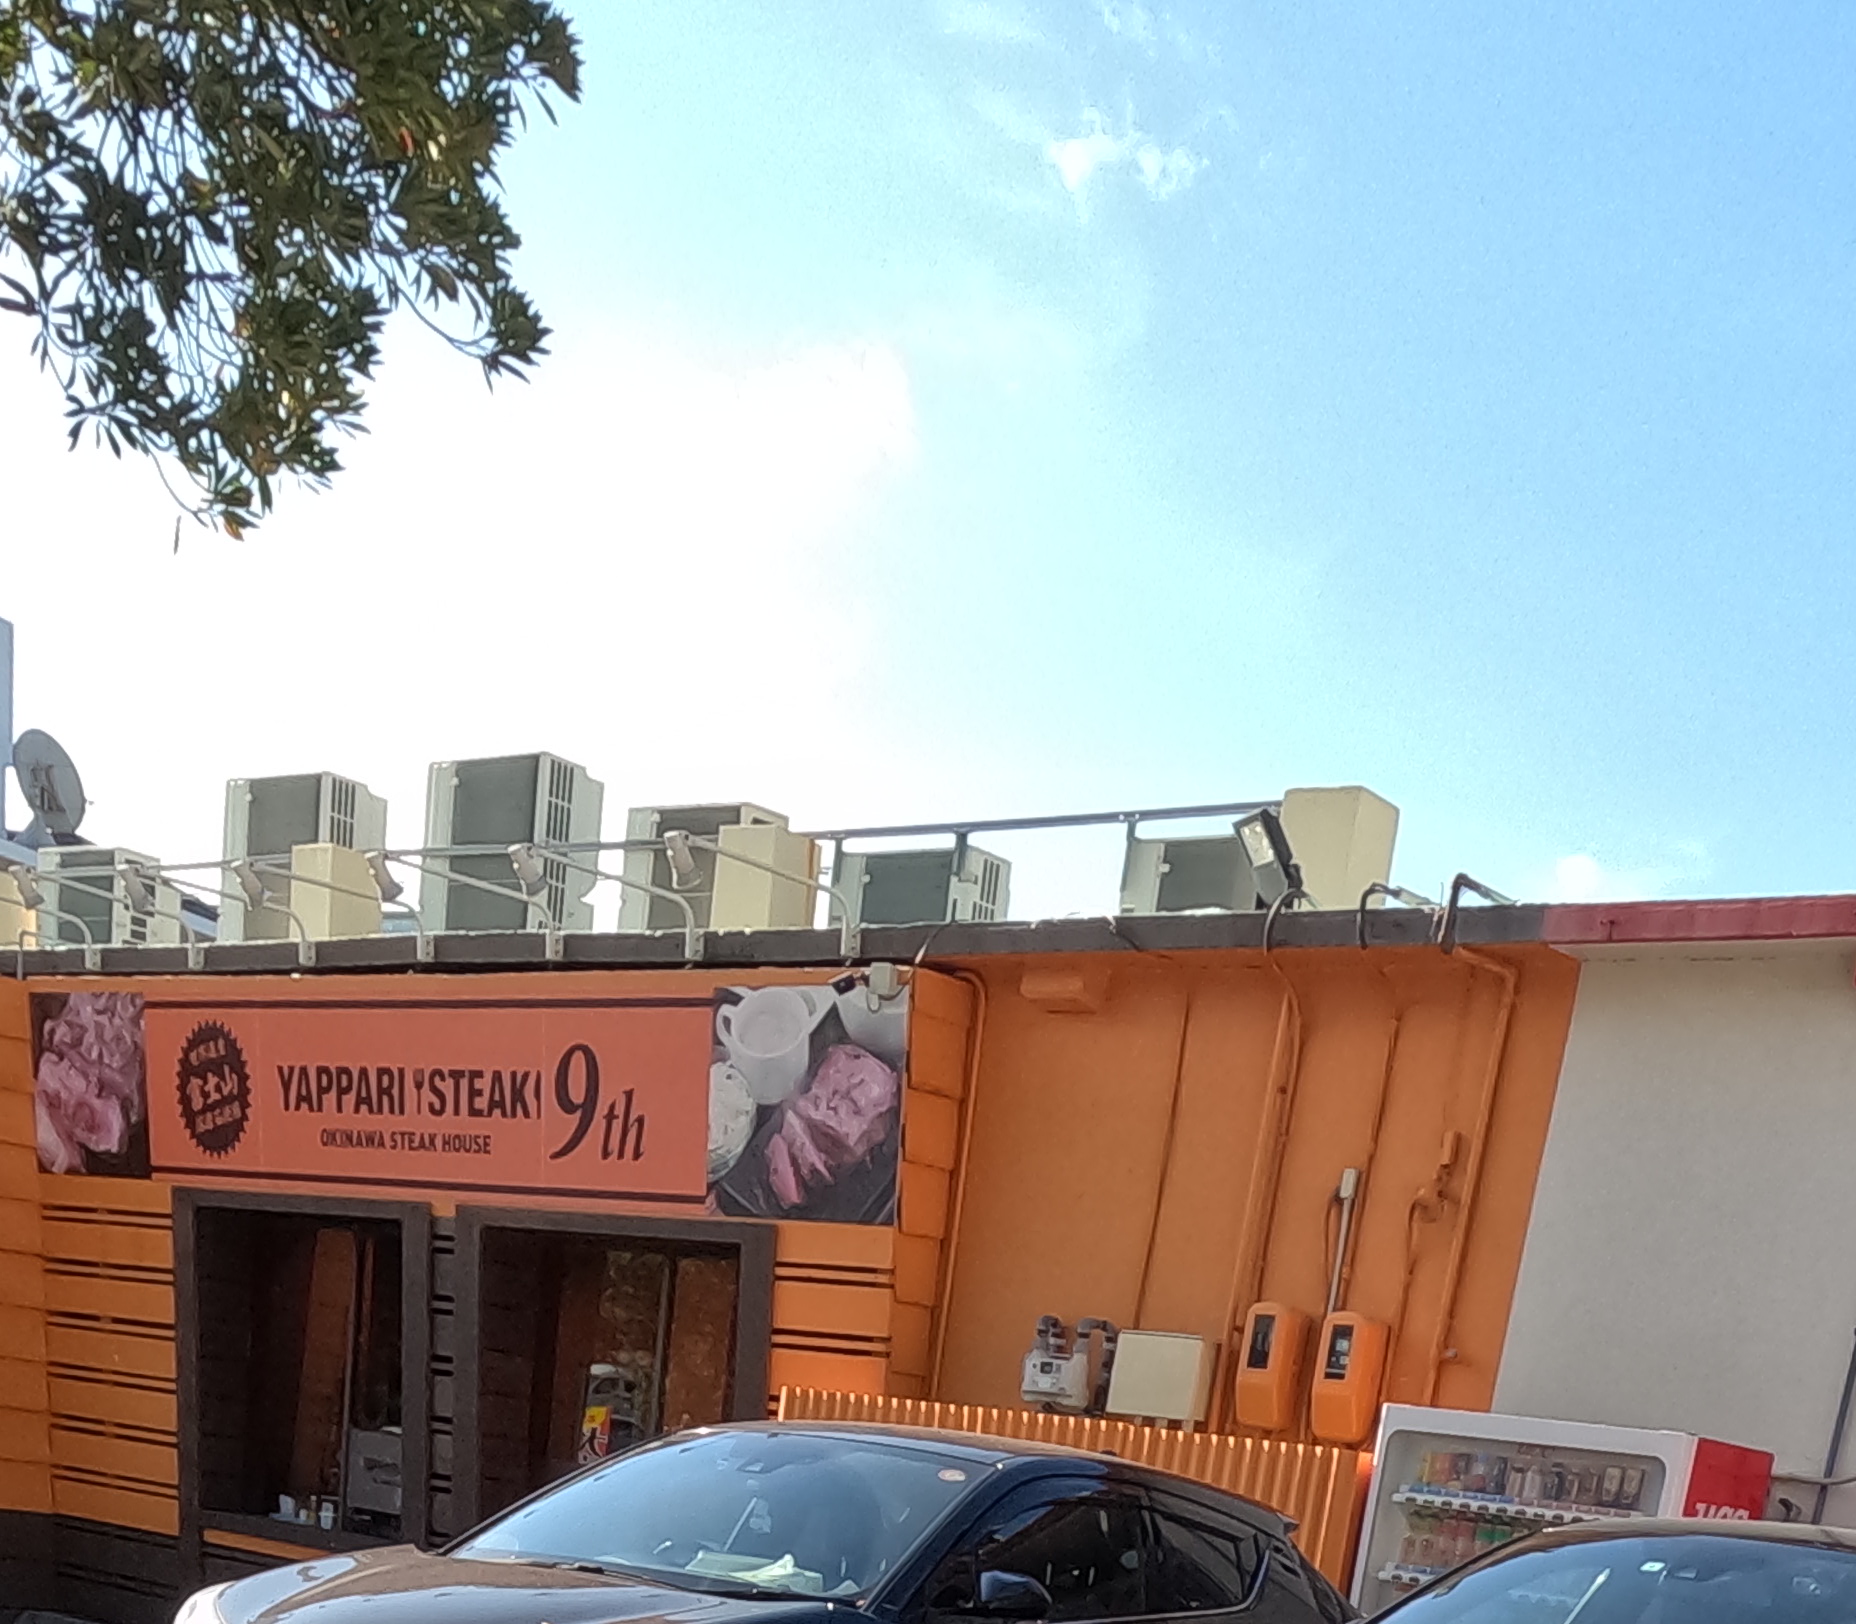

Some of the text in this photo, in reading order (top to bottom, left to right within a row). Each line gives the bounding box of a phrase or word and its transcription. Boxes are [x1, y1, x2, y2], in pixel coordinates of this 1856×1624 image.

[277, 1042, 645, 1161] YAPPARI STEAK 9th
[320, 1129, 491, 1155] OKINAWA STEAK HOUSE
